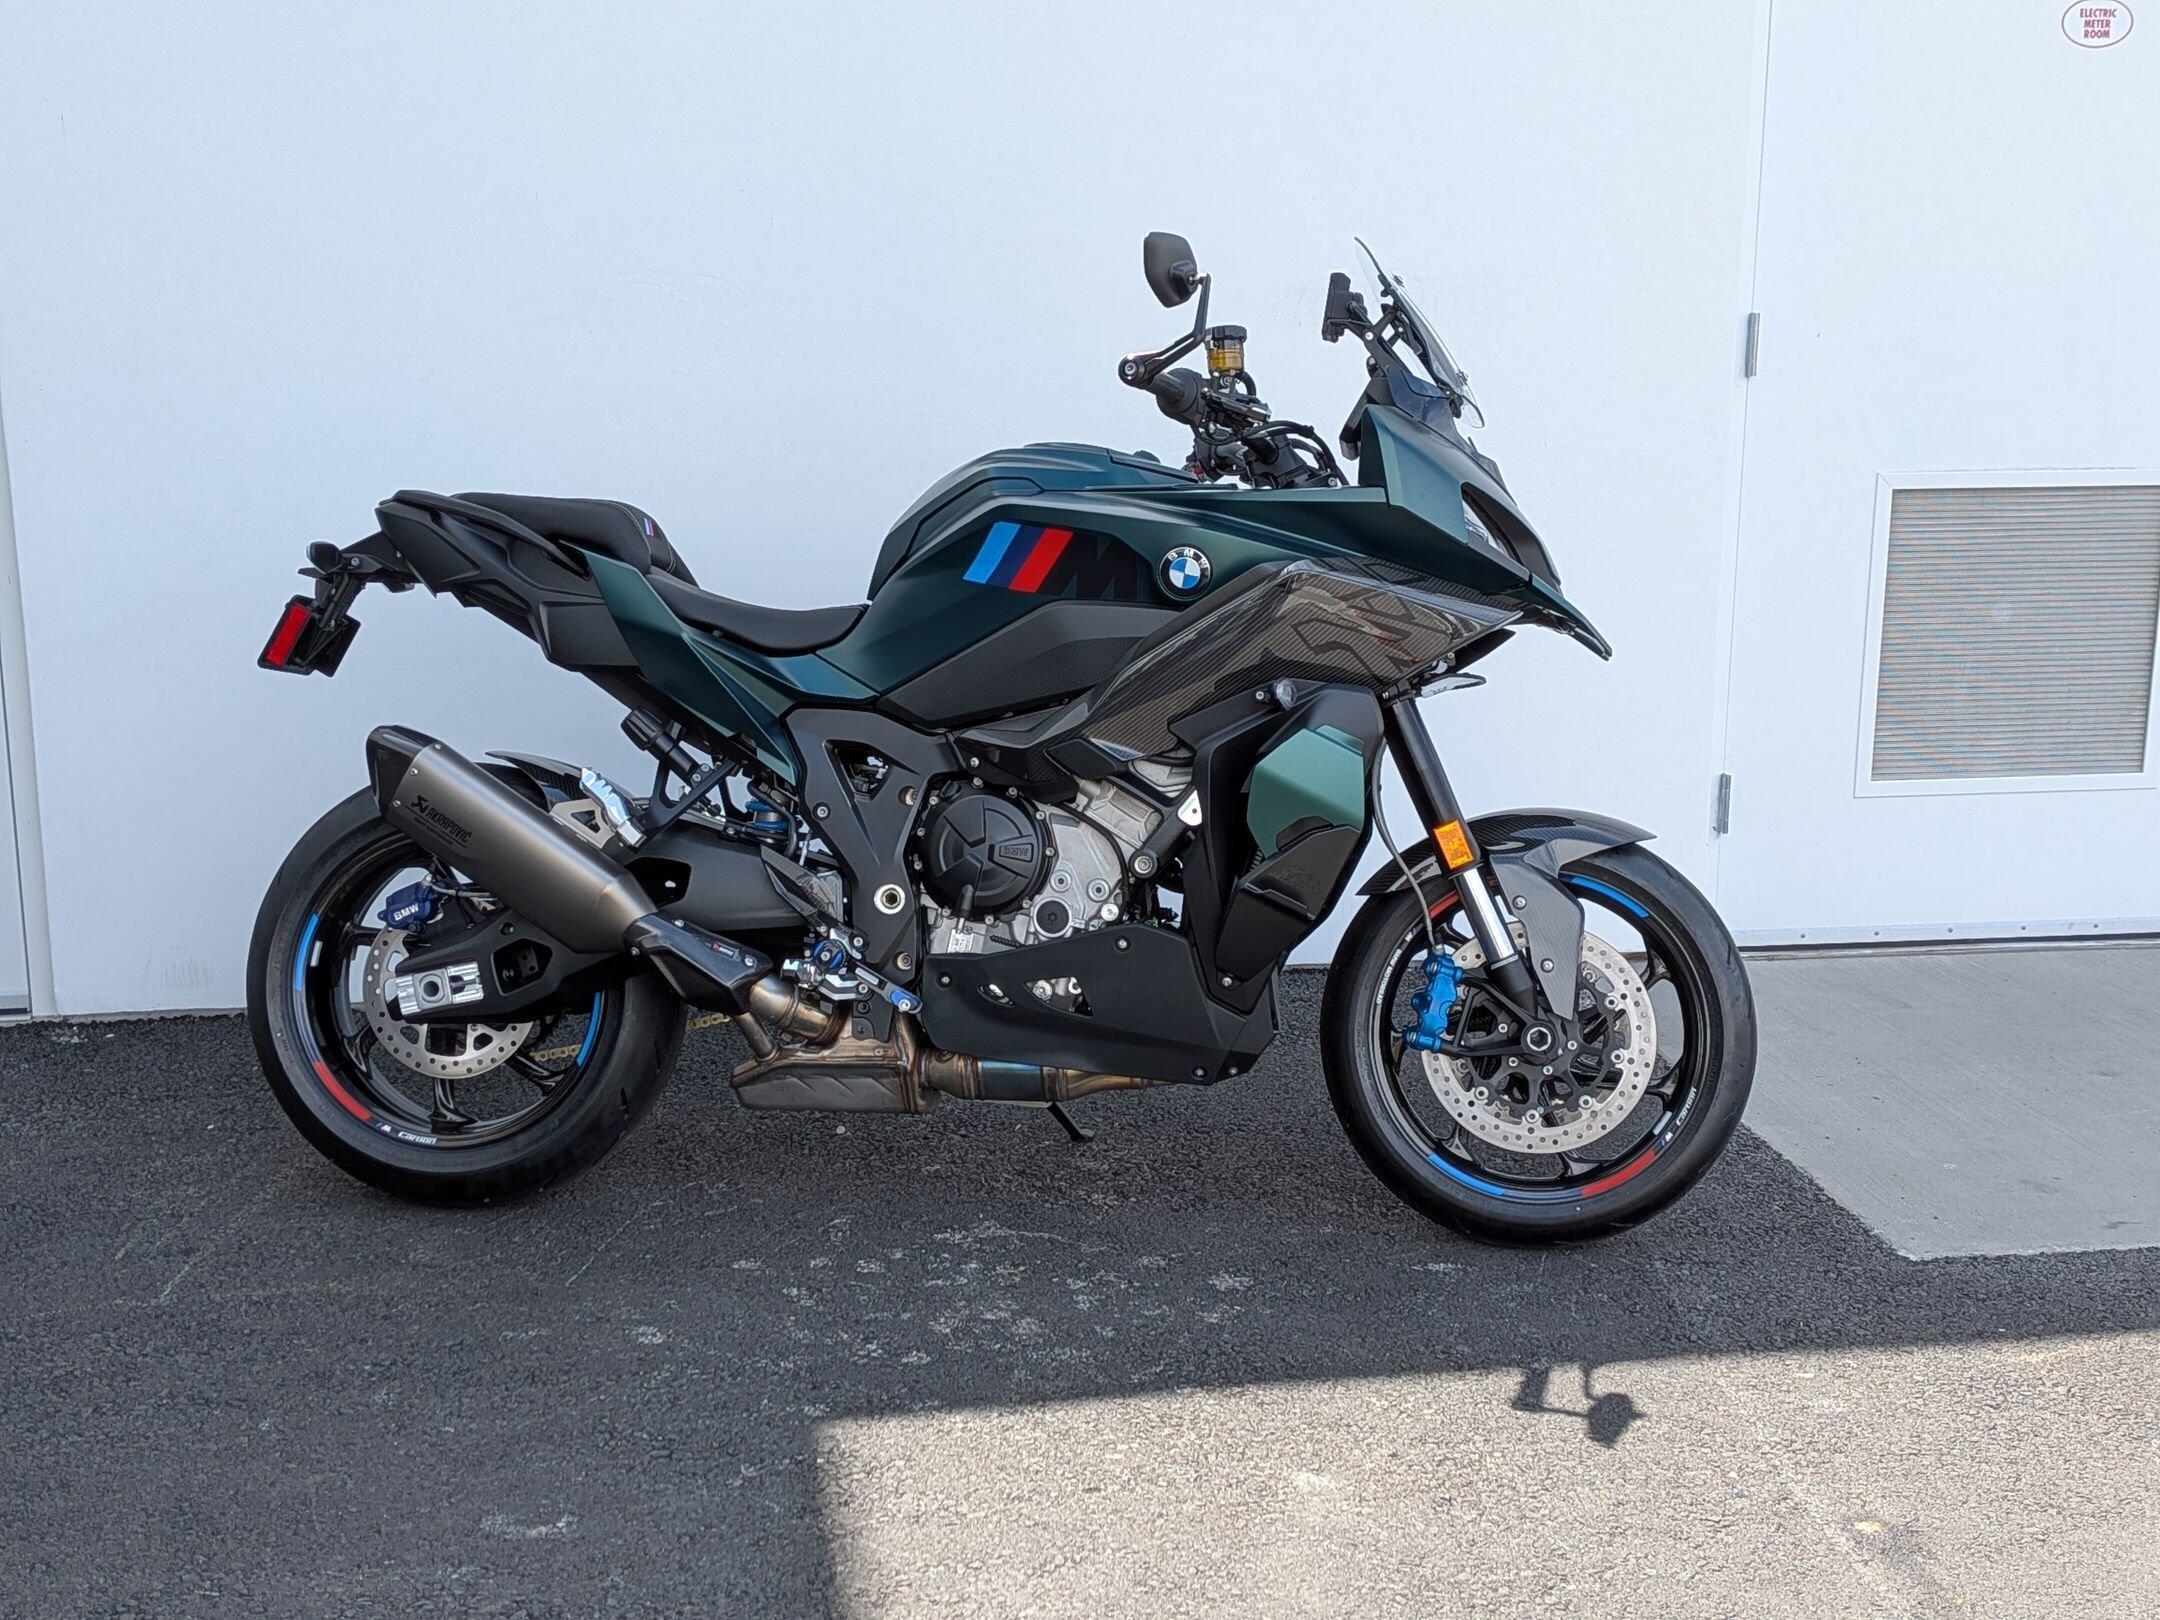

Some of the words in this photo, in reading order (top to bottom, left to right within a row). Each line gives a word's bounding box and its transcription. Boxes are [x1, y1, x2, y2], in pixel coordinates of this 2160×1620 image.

[2079, 8, 2117, 18] ELECTRIC
[2083, 19, 2111, 28] METER
[2083, 29, 2110, 39] ROOM
[1168, 548, 1209, 568] BMW
[393, 902, 419, 921] BMW
